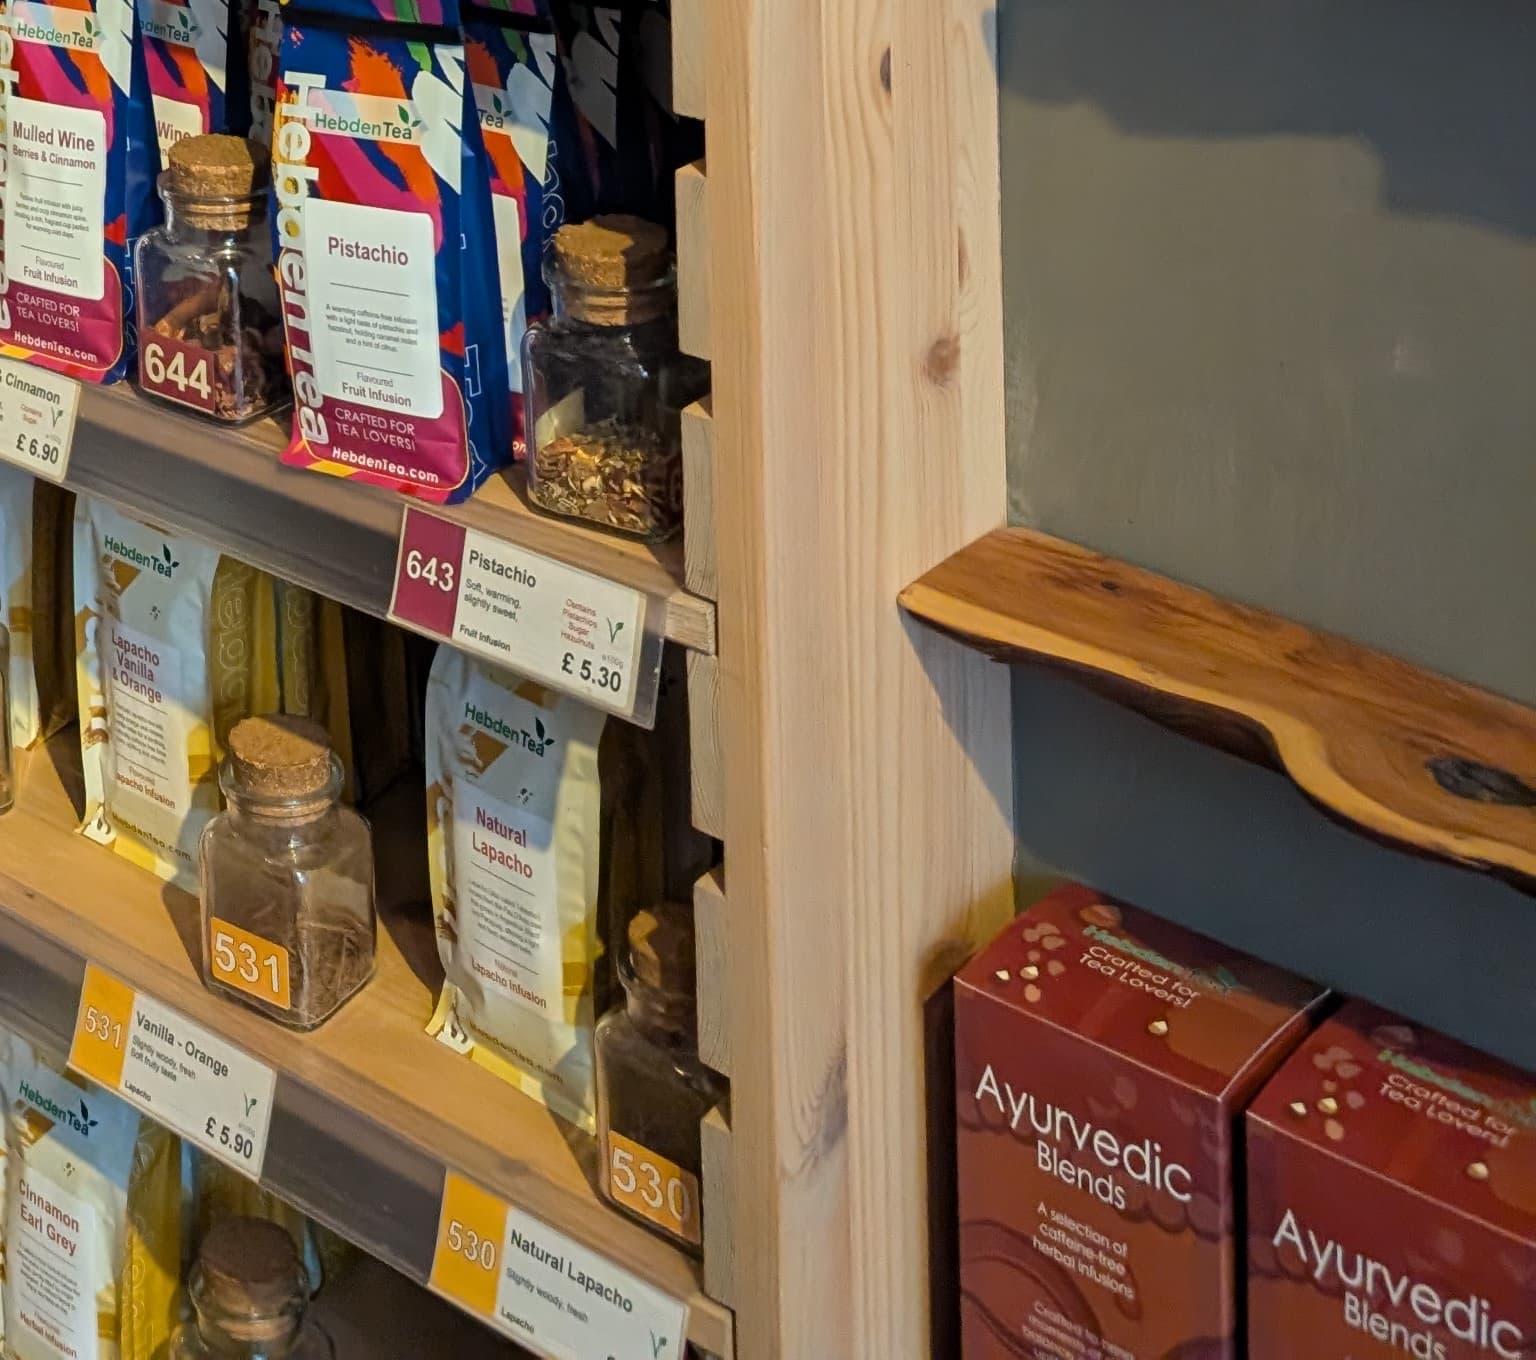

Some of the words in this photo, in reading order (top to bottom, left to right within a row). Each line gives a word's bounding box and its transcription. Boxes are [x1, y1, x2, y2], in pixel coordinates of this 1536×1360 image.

[314, 112, 413, 141] HebdenTea
[327, 236, 409, 267] Pistachio
[2, 373, 61, 405] Cinnamon
[144, 343, 211, 399] 644
[334, 407, 387, 432] CRAFTED
[389, 417, 416, 437] FOR
[335, 422, 359, 439] TEA
[362, 428, 416, 453] LOVERS!
[16, 433, 26, 454] £
[28, 436, 59, 464] 6.90
[331, 447, 440, 484] HebdenTea.com
[405, 551, 454, 592] 643
[467, 548, 537, 588] Pistachio
[560, 651, 575, 676] £
[579, 659, 621, 692] 5.30
[475, 806, 528, 848] Natural
[471, 836, 533, 878] Lapacho
[214, 934, 282, 994] 531
[1079, 952, 1116, 978] Tea
[1088, 945, 1174, 989] Crafted
[84, 1005, 122, 1048] 531
[136, 1011, 175, 1044] Vanilla
[185, 1041, 229, 1079] Orange
[205, 1117, 216, 1137] £
[219, 1123, 253, 1160] 5.90
[975, 1064, 1192, 1203] Ayurvedic
[611, 1147, 692, 1221] 530
[1036, 1139, 1127, 1210] Blends
[18, 1178, 79, 1232] Cinnamon
[20, 1206, 46, 1231] Earl
[48, 1219, 77, 1256] Grey
[447, 1218, 496, 1270] 530
[511, 1229, 563, 1272] Natural
[566, 1257, 633, 1314] Lapacho
